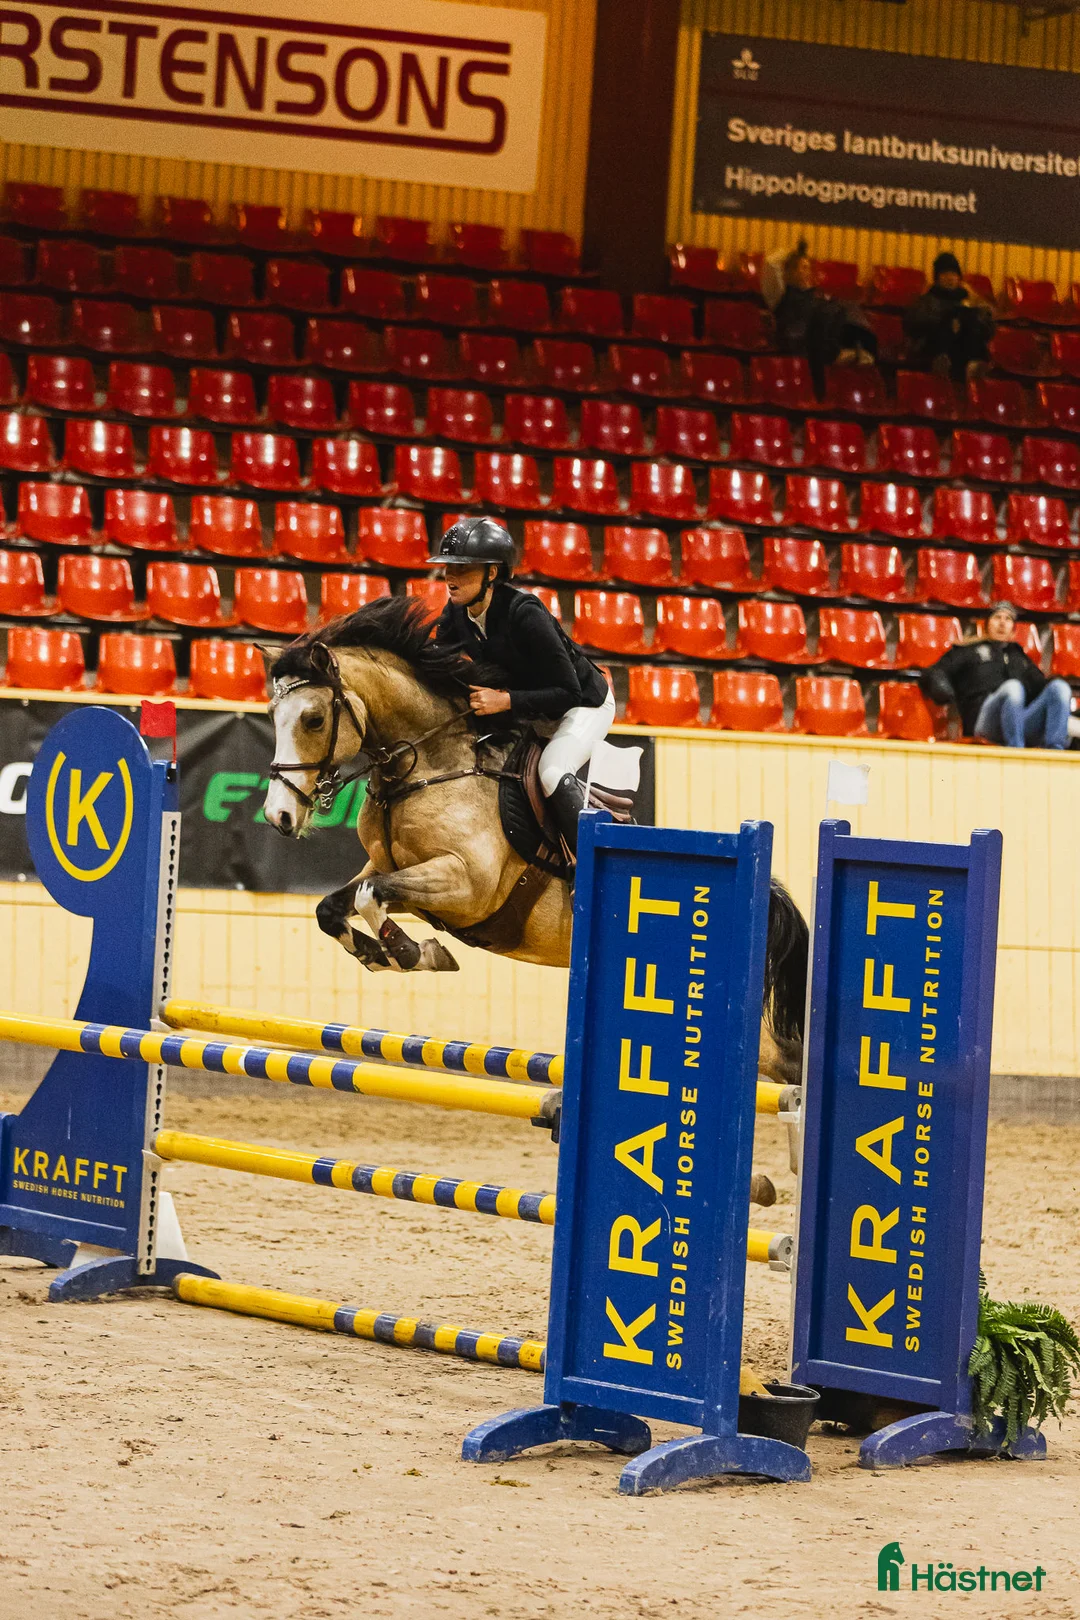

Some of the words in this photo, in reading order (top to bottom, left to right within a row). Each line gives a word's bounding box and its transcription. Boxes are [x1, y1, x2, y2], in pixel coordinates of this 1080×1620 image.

[724, 166, 977, 214] Hippologprogrammet
[727, 117, 837, 153] Sveriges
[66, 768, 114, 851] K
[685, 886, 710, 1068] NUTRITION
[919, 889, 944, 1063] NUTRITION
[603, 876, 681, 1365] KRAFFT
[677, 1087, 699, 1197] HORSE
[845, 880, 916, 1349] KRAFFT
[913, 1081, 934, 1187] HORSE
[13, 1180, 49, 1194] SWEDISH
[51, 1187, 78, 1200] HORSE
[81, 1193, 125, 1208] NUTRITION
[14, 1147, 128, 1193] KRAFFT
[666, 1217, 690, 1370] SWEDISH
[904, 1206, 927, 1353] SWEDISH
